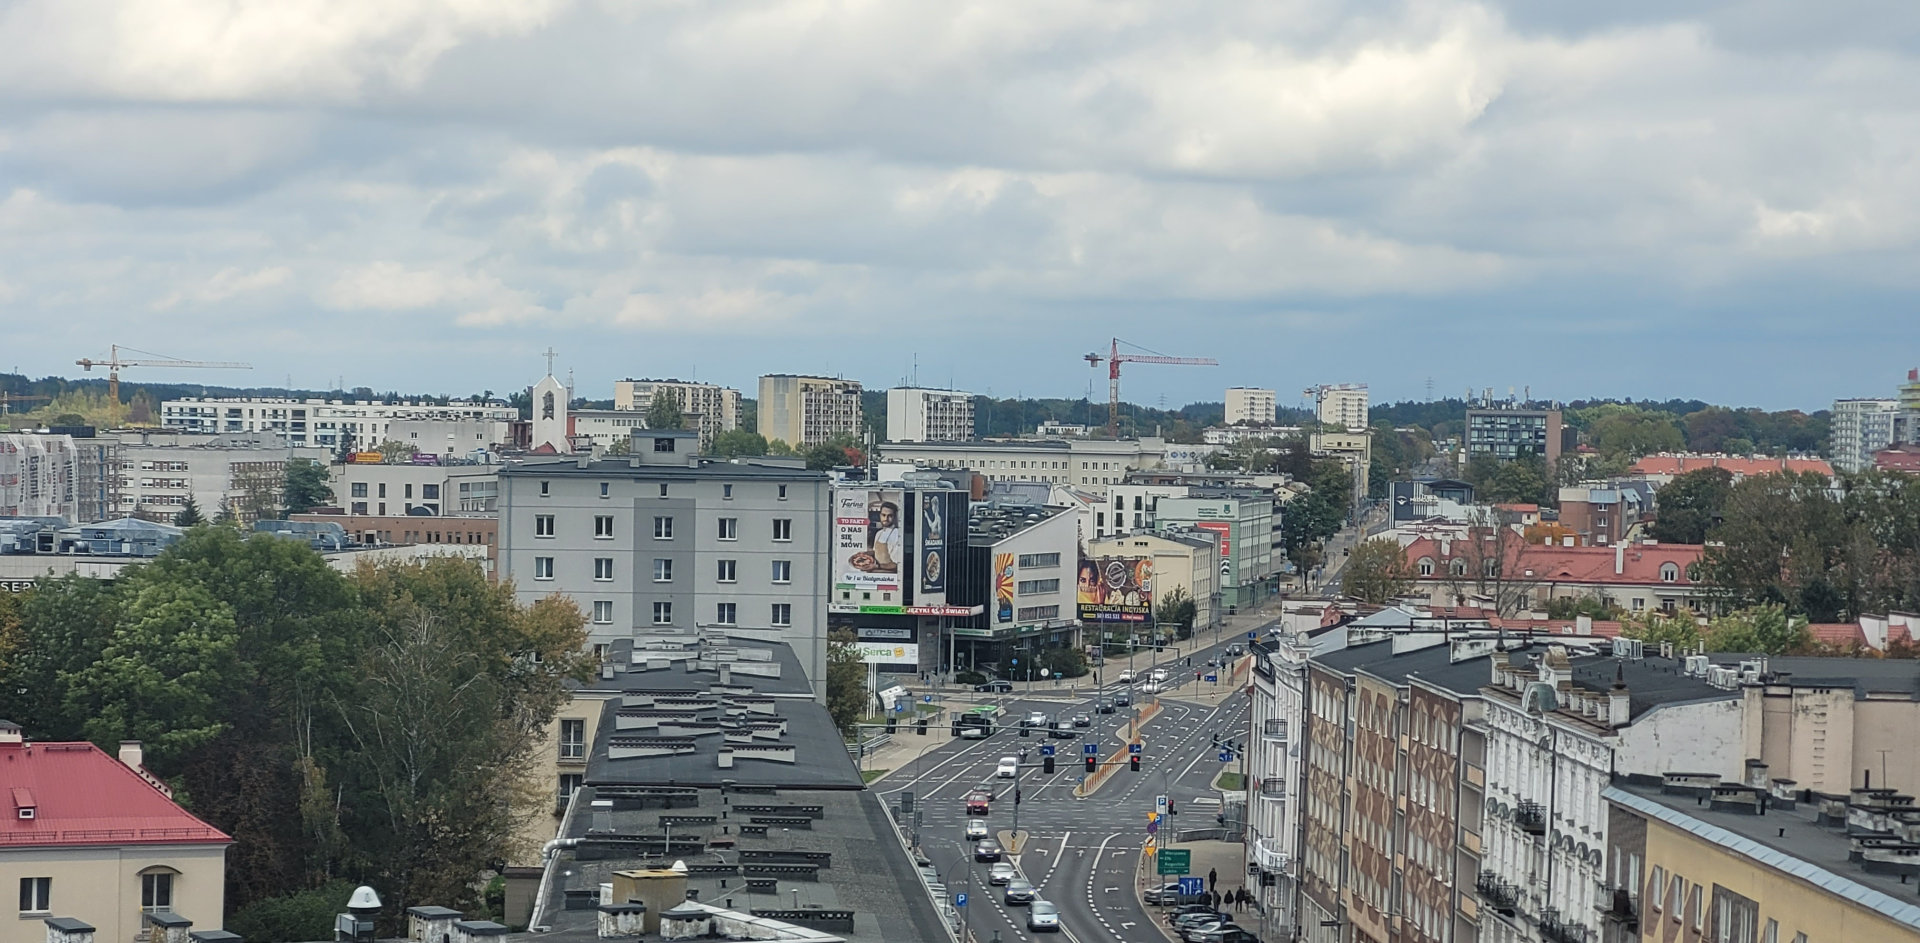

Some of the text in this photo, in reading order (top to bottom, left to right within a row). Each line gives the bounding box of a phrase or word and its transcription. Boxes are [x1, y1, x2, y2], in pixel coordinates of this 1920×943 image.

[30, 455, 39, 500] Baumit
[64, 459, 73, 502] Baumit
[841, 498, 864, 508] Farina
[1080, 604, 1149, 614] RESTAURACJA INDYJSKA
[863, 647, 892, 657] Serca
[958, 894, 965, 903] P
